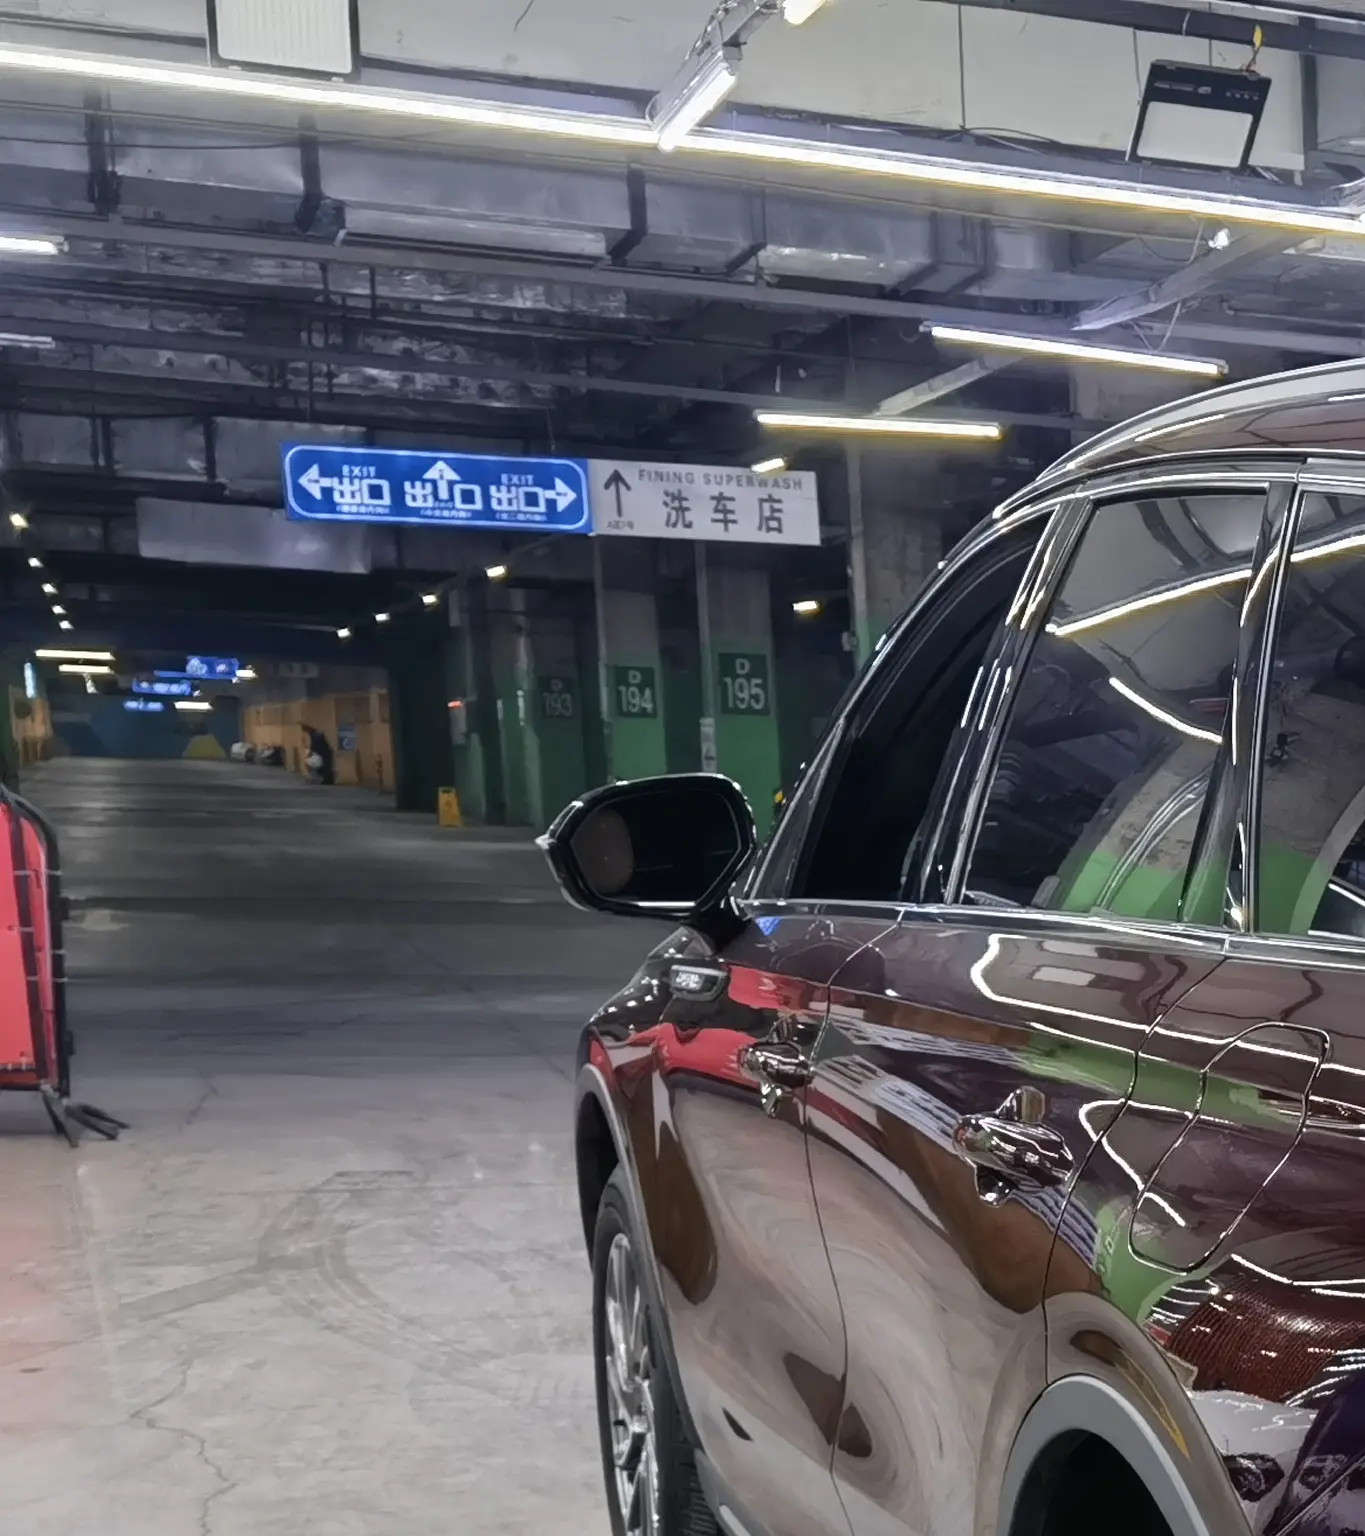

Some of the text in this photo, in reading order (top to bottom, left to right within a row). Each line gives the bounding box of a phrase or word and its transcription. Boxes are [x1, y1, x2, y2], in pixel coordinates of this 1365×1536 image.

[342, 464, 376, 477] EXIT
[501, 473, 534, 485] EXIT
[702, 472, 803, 490] SUPERWASH
[332, 477, 391, 506] 出口
[404, 481, 483, 511] 出口
[489, 485, 546, 513] 出口
[662, 489, 784, 534] 洗车店
[628, 671, 641, 684] D
[735, 658, 750, 674] D
[618, 685, 653, 713] 194
[723, 677, 765, 710] 195
